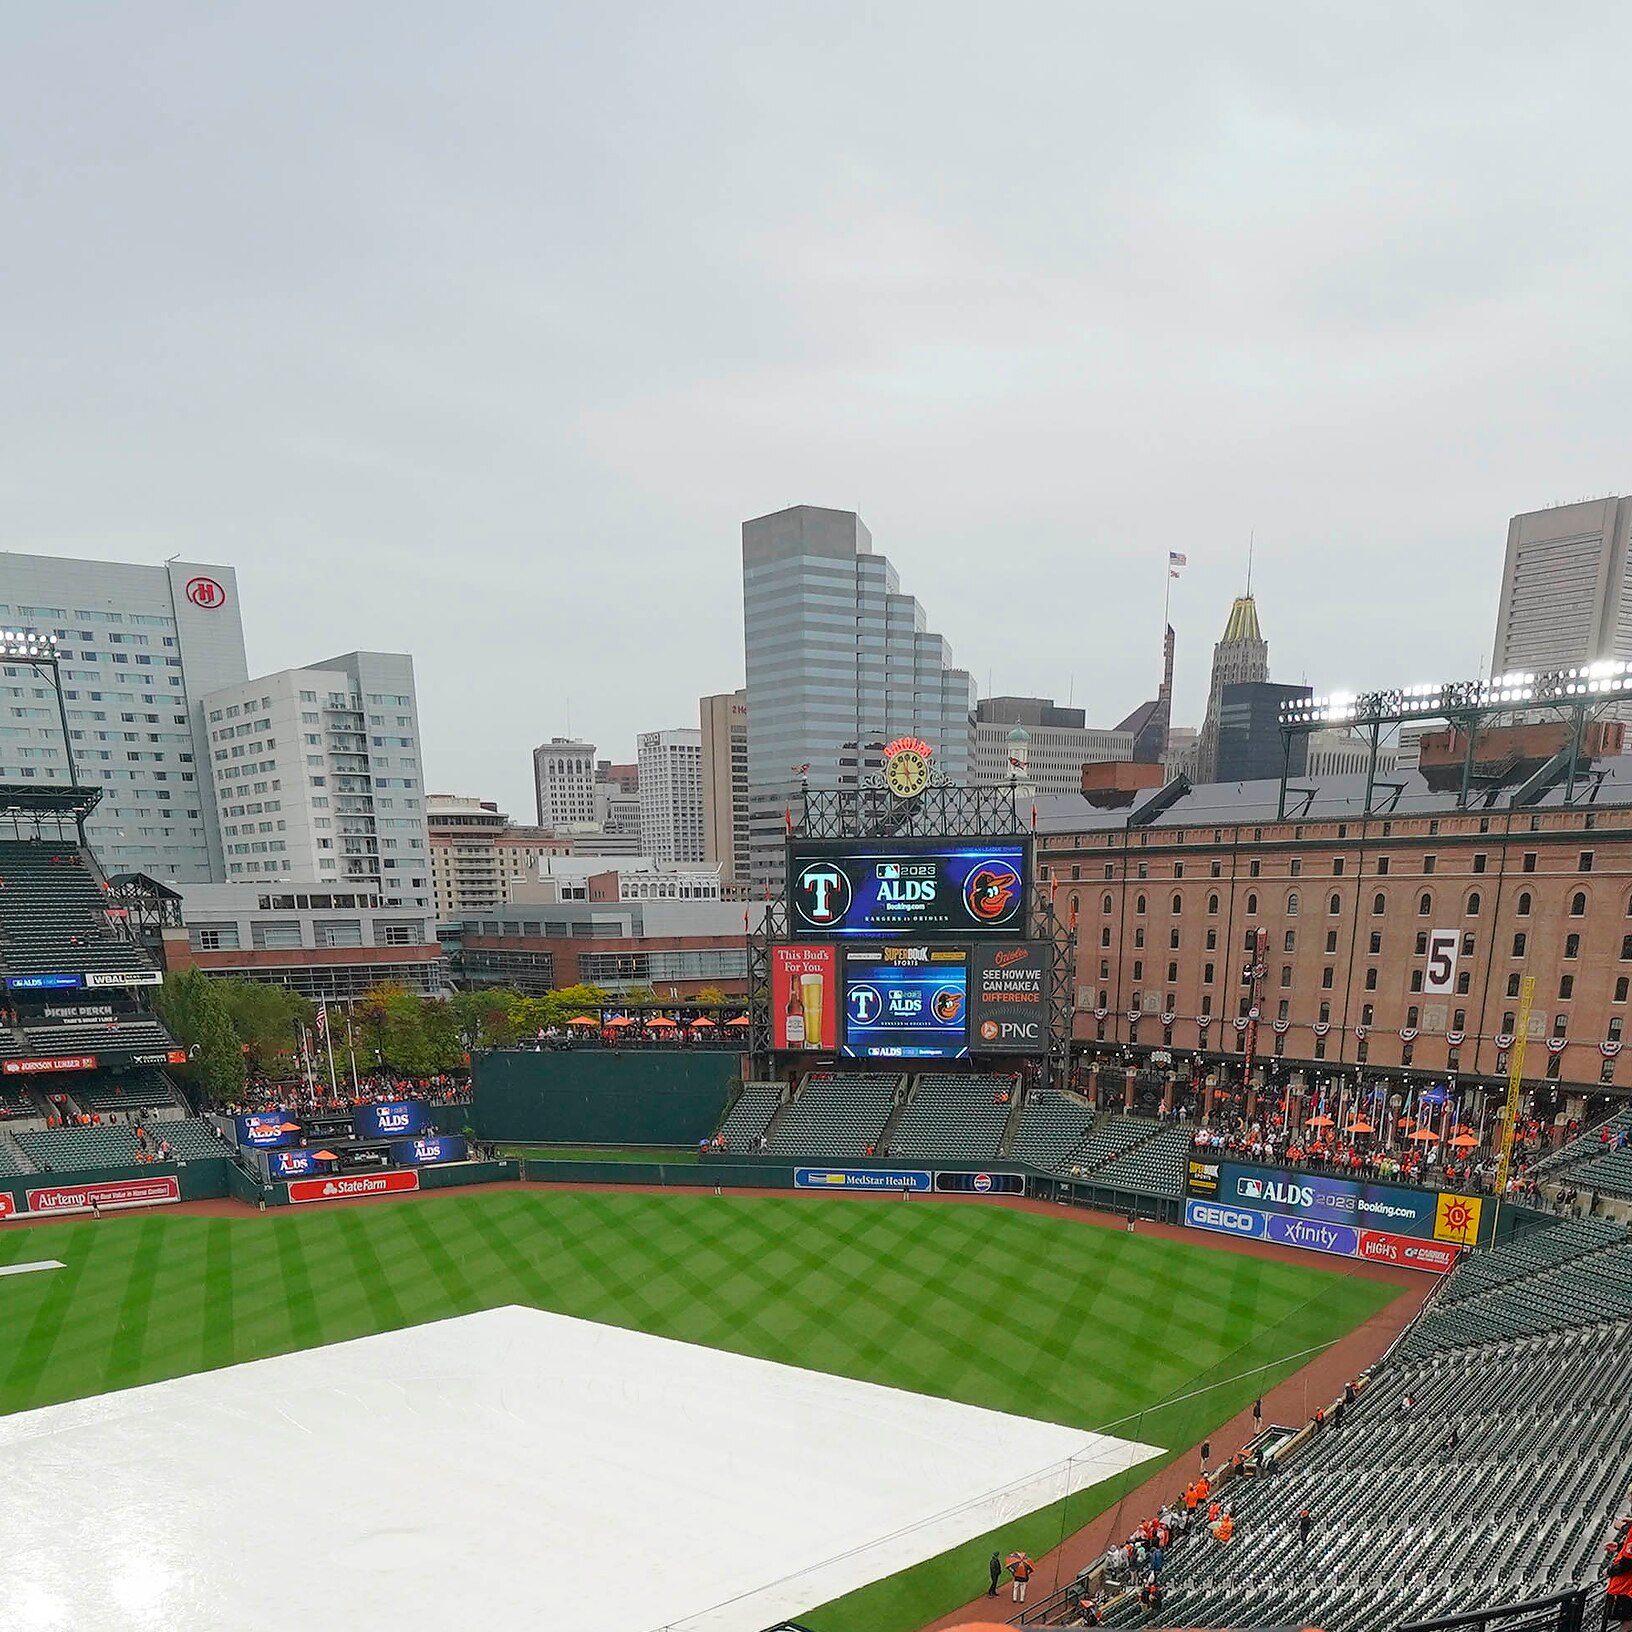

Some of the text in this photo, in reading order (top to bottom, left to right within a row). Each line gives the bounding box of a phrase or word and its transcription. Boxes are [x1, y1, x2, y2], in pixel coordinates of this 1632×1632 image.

[900, 866, 936, 876] 2023
[877, 880, 935, 901] ALDS
[778, 950, 801, 960] This
[784, 962, 823, 972] For You.
[1429, 938, 1454, 985] 5
[93, 974, 124, 984] WBAL
[983, 970, 1041, 980] SEE HOW WE
[983, 981, 1040, 991] CAN MAKE A
[982, 993, 1040, 1002] DIFFERENCE
[889, 1000, 922, 1011] ALDS
[45, 1006, 112, 1017] PICNIC PERCH
[1001, 1023, 1038, 1038] PNC
[880, 1047, 902, 1057] ALDS
[21, 1060, 80, 1071] JOHNSON LUMBER
[378, 1114, 409, 1128] ALDS
[415, 1145, 441, 1158] ALDS
[847, 1175, 917, 1186] MedStar Health
[39, 1192, 85, 1210] Airtemp
[1263, 1180, 1415, 1219] ALDS 2023 Booking.com
[1192, 1206, 1253, 1230] GEICO
[1285, 1221, 1338, 1249] xfinity
[1365, 1241, 1397, 1259] HIGH'S
